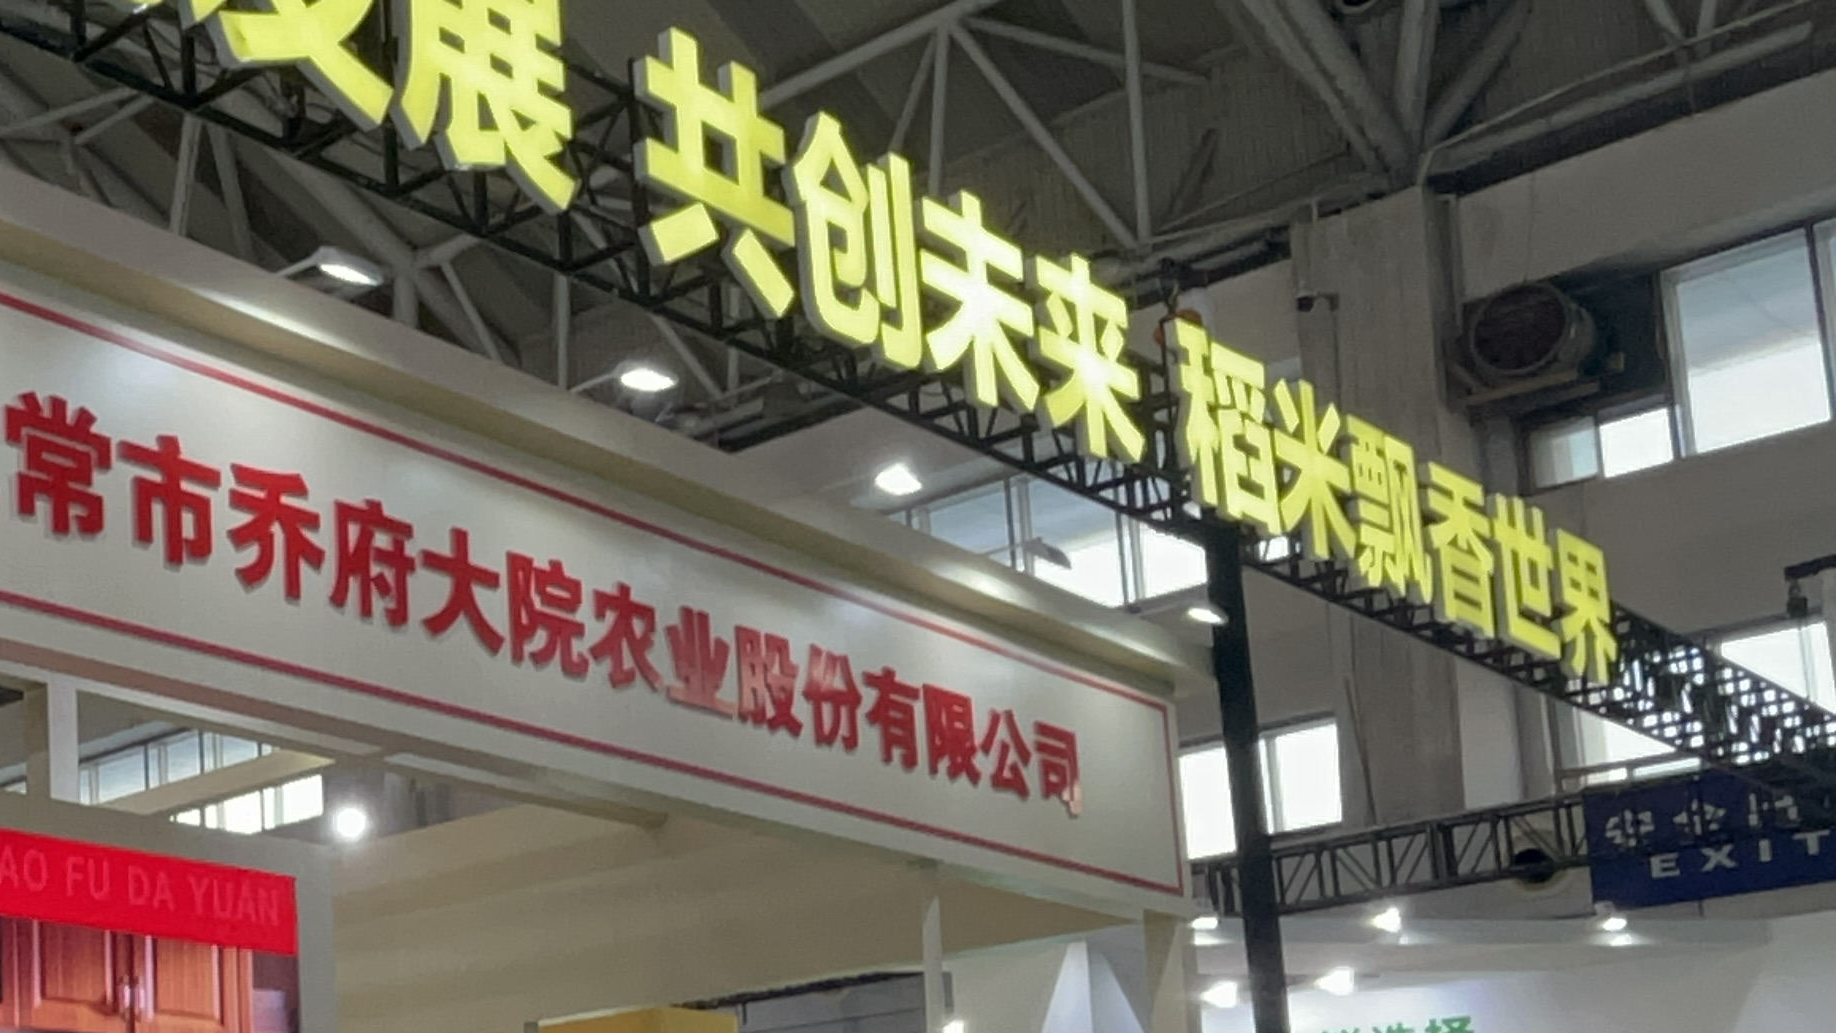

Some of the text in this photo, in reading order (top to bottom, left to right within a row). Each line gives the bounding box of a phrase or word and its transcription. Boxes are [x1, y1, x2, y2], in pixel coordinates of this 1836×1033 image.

[634, 27, 1146, 464] 共创未来
[1174, 316, 1618, 686] 稻米飘香世界
[1650, 829, 1831, 879] EXIT
[66, 856, 111, 900] FU
[127, 865, 176, 912] DA
[187, 873, 280, 927] YUAN
